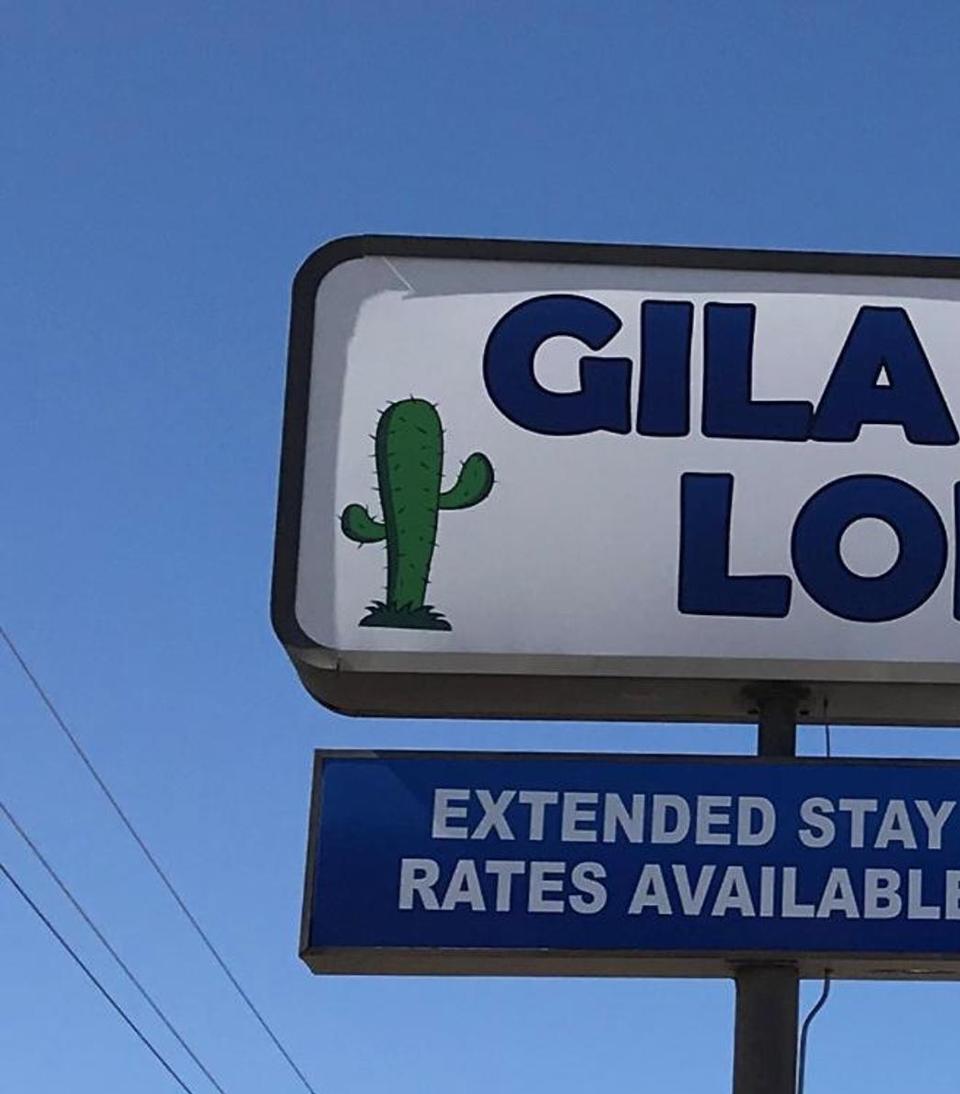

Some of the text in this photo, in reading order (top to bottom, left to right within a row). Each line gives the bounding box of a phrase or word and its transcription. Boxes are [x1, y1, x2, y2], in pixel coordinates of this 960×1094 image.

[483, 294, 959, 446] GILA
[432, 788, 956, 850] EXTENDED STAY
[399, 858, 607, 914] RATES
